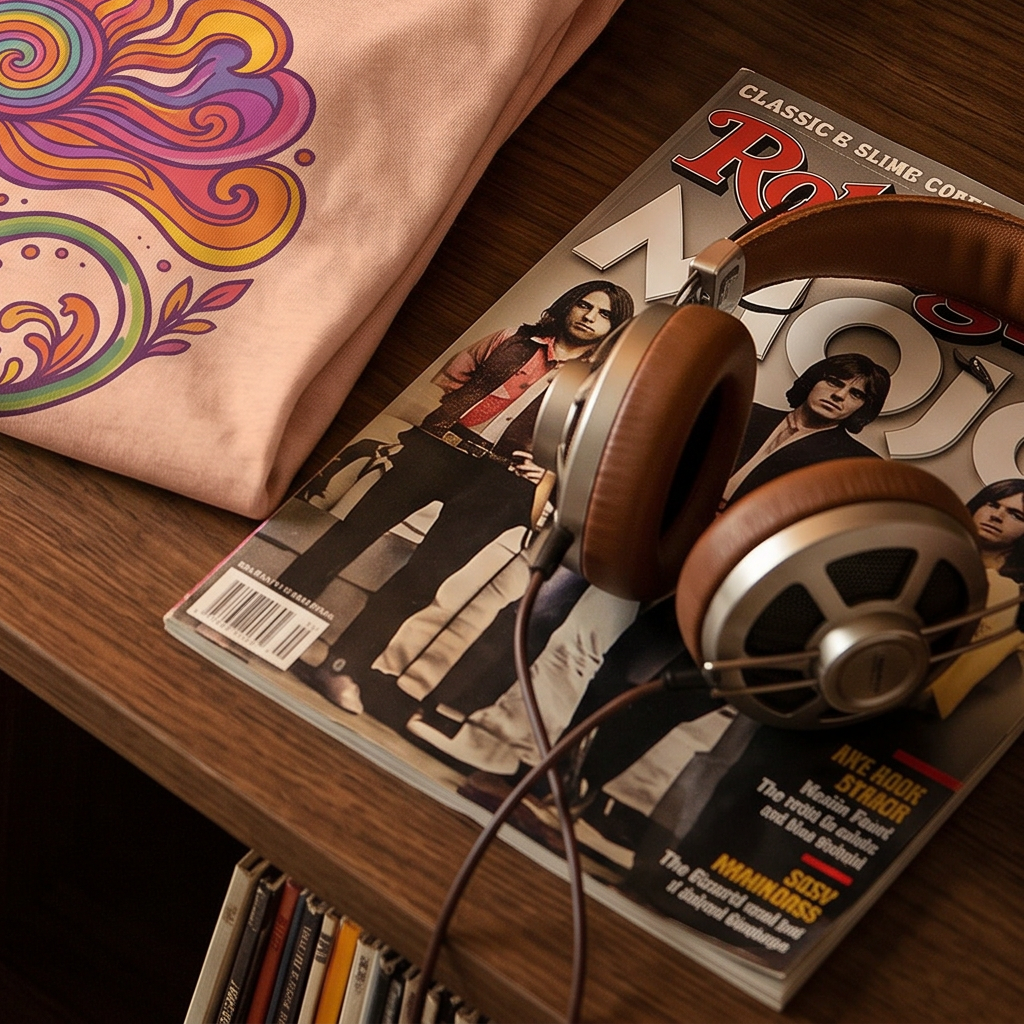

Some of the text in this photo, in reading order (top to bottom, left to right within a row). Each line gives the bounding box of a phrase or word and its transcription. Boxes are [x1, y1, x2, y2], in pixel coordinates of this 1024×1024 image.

[738, 84, 835, 138] CLASSIC
[831, 131, 854, 149] B
[853, 142, 924, 184] SLIMB
